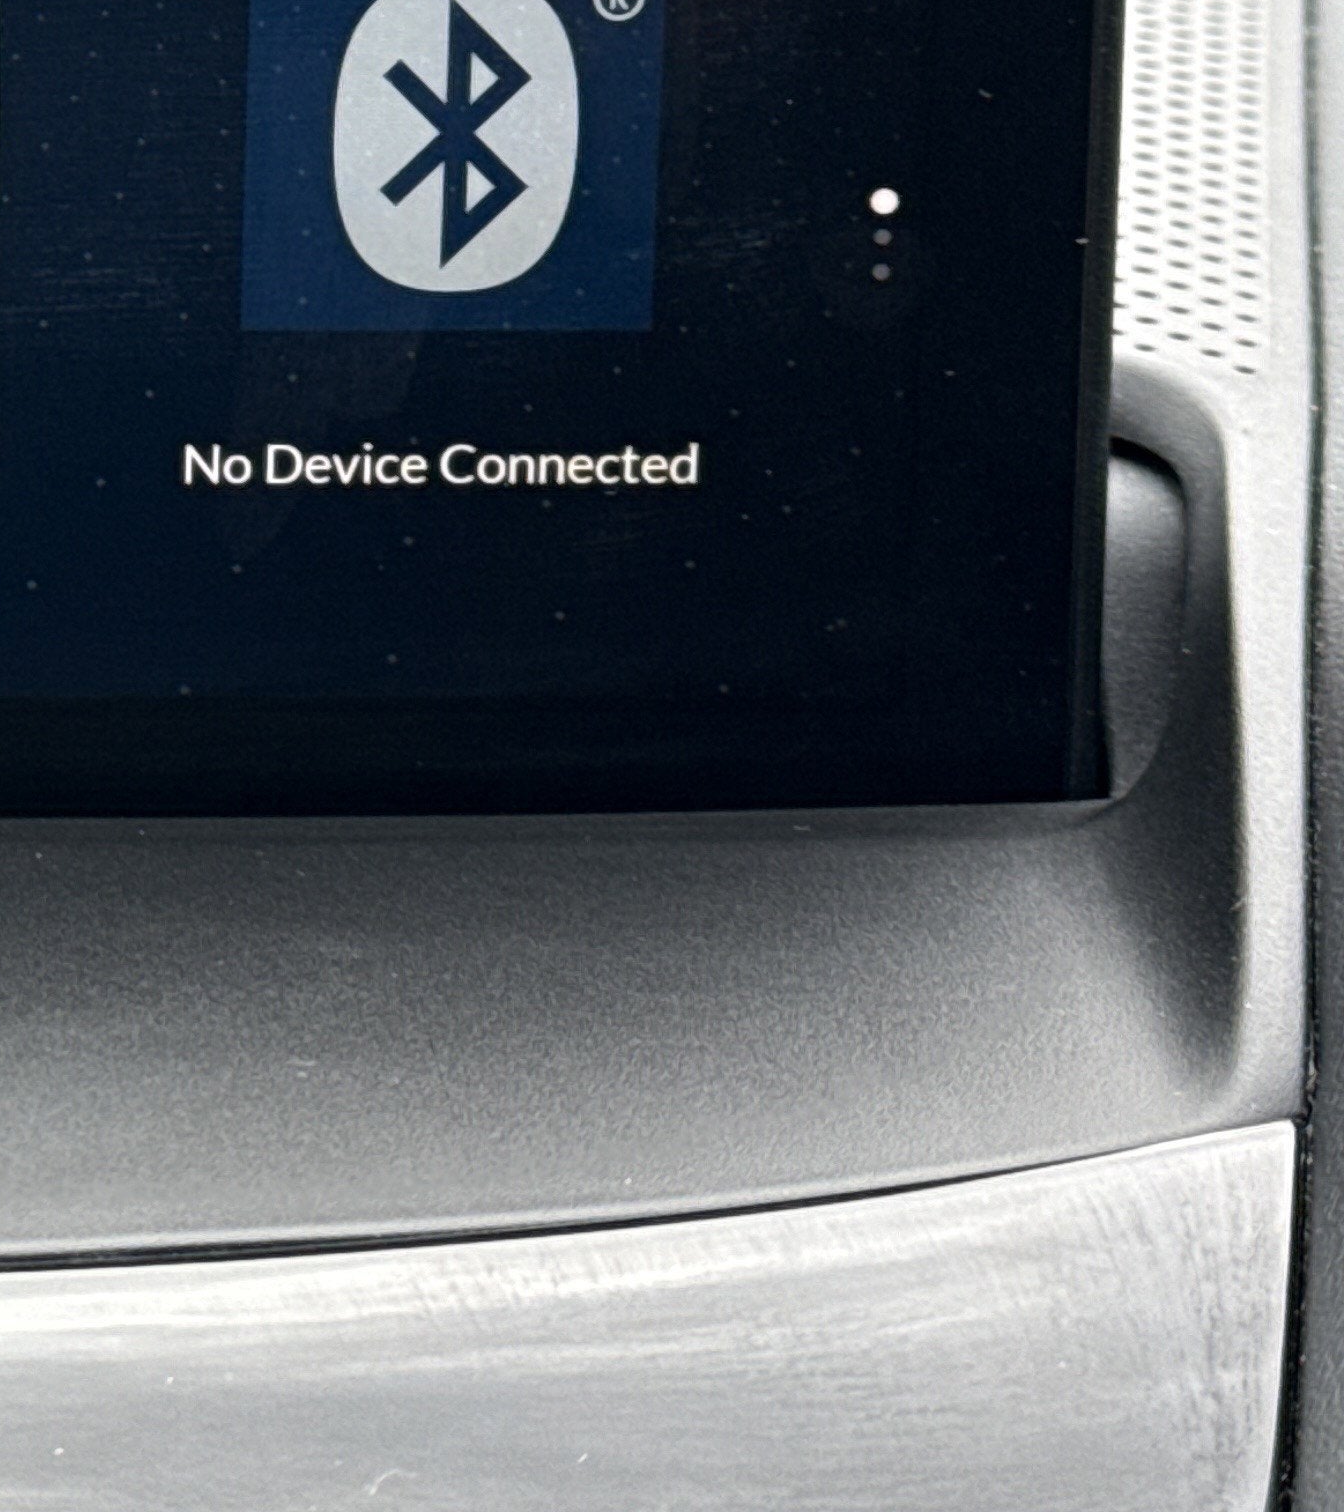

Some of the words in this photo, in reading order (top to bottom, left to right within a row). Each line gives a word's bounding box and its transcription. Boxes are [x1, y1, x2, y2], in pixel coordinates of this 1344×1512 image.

[183, 444, 252, 484] No
[264, 443, 428, 484] Device
[440, 443, 700, 485] Connected
